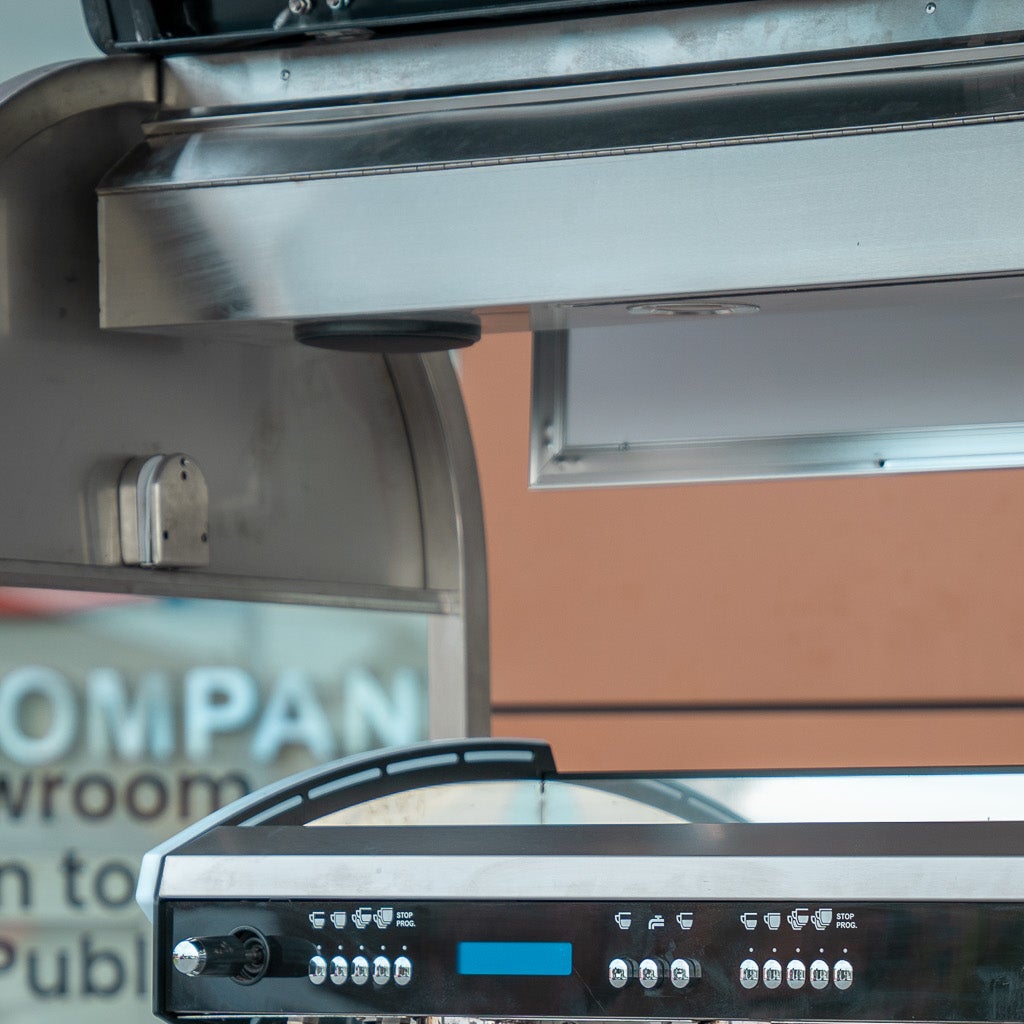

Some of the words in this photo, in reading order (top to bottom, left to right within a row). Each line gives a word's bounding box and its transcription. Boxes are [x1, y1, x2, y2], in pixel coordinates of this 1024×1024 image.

[61, 847, 137, 908] to
[396, 911, 414, 919] STOP
[836, 912, 855, 921] STOP
[396, 920, 416, 928] PROG.
[836, 921, 858, 929] PROG.
